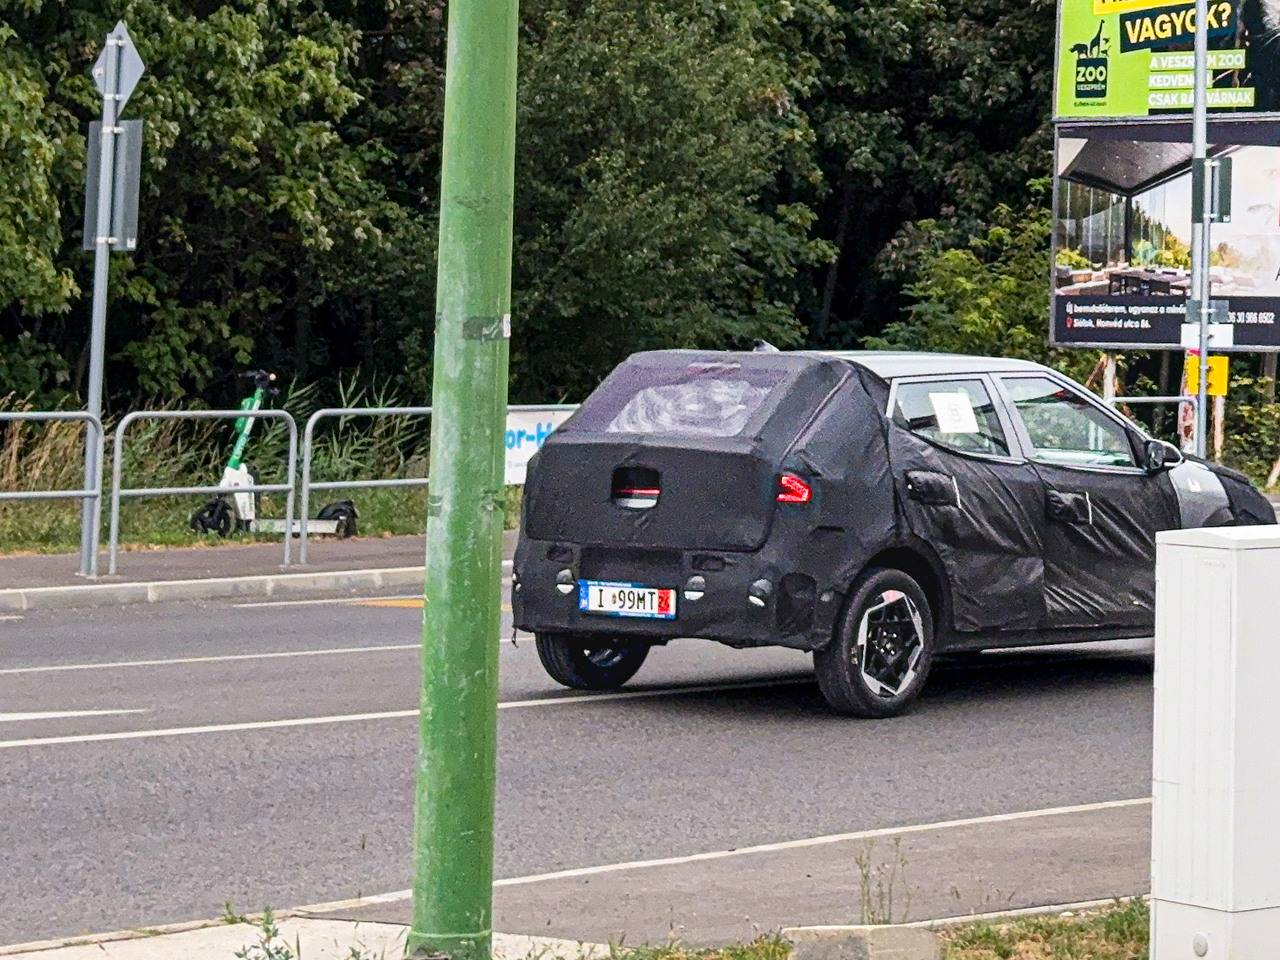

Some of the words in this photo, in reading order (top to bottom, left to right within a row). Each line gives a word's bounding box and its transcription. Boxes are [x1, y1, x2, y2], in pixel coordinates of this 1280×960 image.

[1149, 56, 1159, 69] A
[1160, 55, 1216, 68] VESZPM
[1218, 53, 1243, 66] ZOO
[1077, 66, 1107, 82] ZOO
[1149, 73, 1212, 87] KEDVENI
[1148, 93, 1179, 106] CSAK
[1207, 89, 1251, 103] VÁRNAK
[598, 589, 604, 608] I
[618, 590, 655, 611] 99MT
